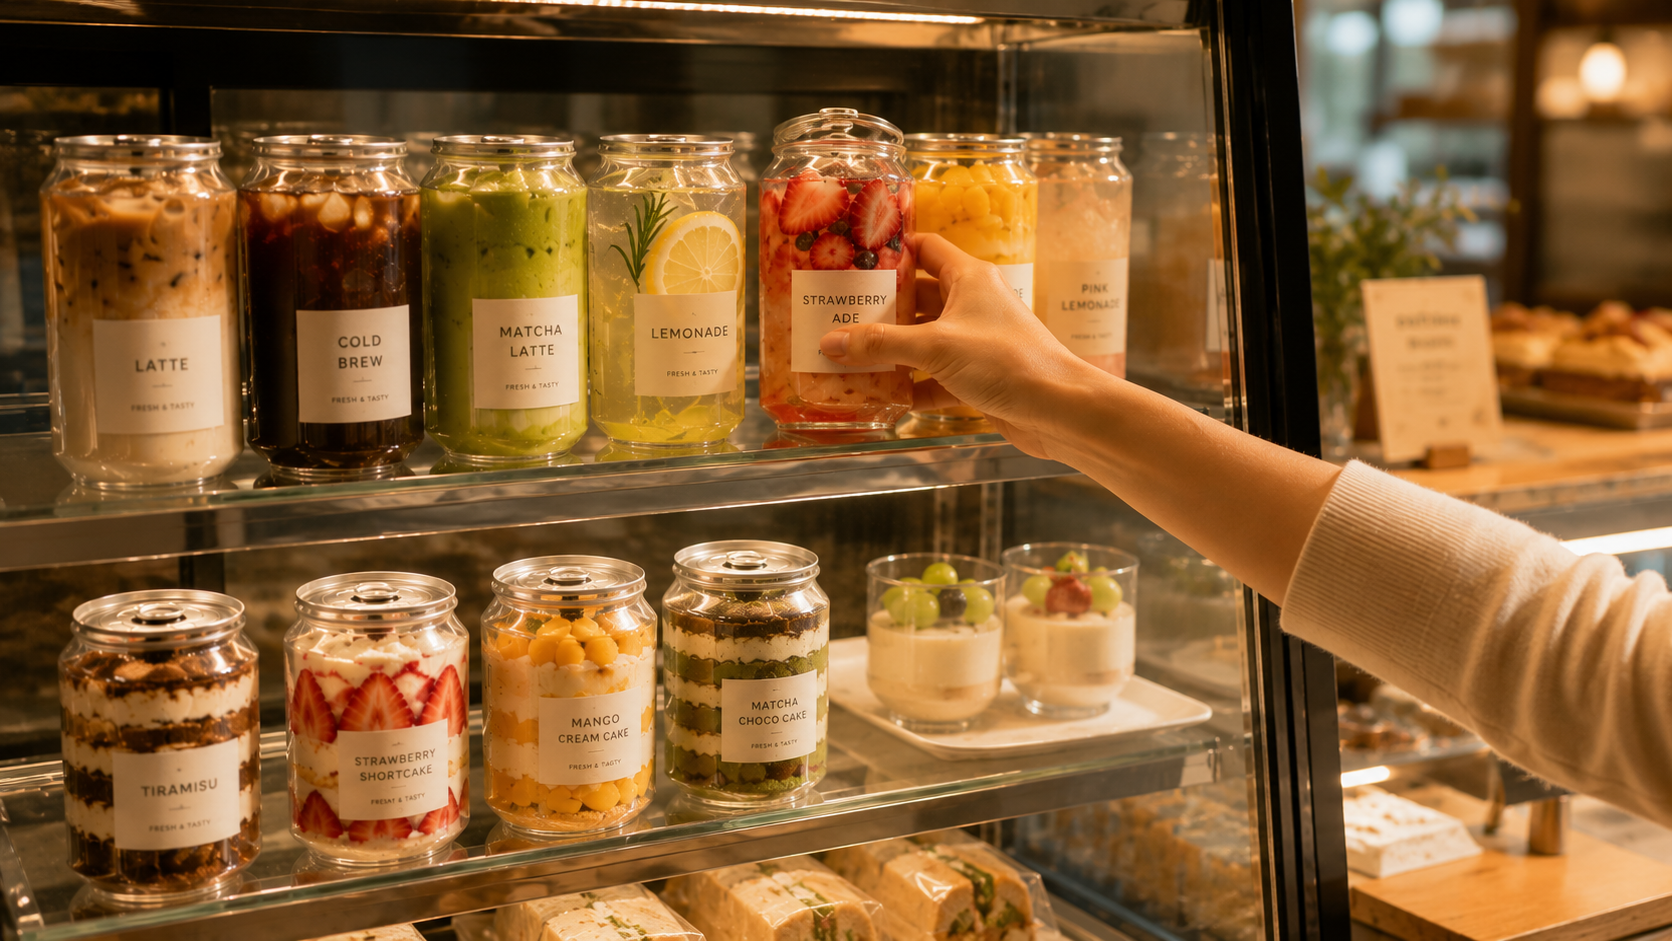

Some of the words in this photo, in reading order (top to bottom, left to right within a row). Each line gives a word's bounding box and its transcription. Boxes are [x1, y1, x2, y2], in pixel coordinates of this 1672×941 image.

[1081, 283, 1109, 294] PINK
[803, 295, 887, 305] STRAWBERRY
[1061, 298, 1120, 311] LEMONADE
[832, 313, 859, 323] ADE
[500, 325, 562, 338] MATCHA
[651, 325, 729, 339] LEMONADE
[338, 335, 381, 348] COLD
[510, 344, 555, 357] LATTE
[135, 357, 189, 373] LATTE
[338, 355, 383, 369] BREW
[539, 381, 560, 389] TASTY
[367, 394, 389, 402] TASTY
[131, 404, 159, 412] FRESH
[170, 402, 195, 410] TASTY
[751, 697, 798, 711] MATCHA
[571, 713, 620, 728] MANGO
[738, 715, 779, 726] CHOCO
[782, 710, 807, 722] CAKE
[558, 733, 600, 744] CREAM
[603, 727, 629, 741] CAKE
[355, 748, 436, 767] STRAWBERRY
[360, 764, 432, 781] SHORTCAKE
[141, 778, 218, 797] TIRAMISU
[405, 792, 426, 802] TASTY
[148, 824, 177, 832] FRESH
[187, 819, 211, 829] TASTY
